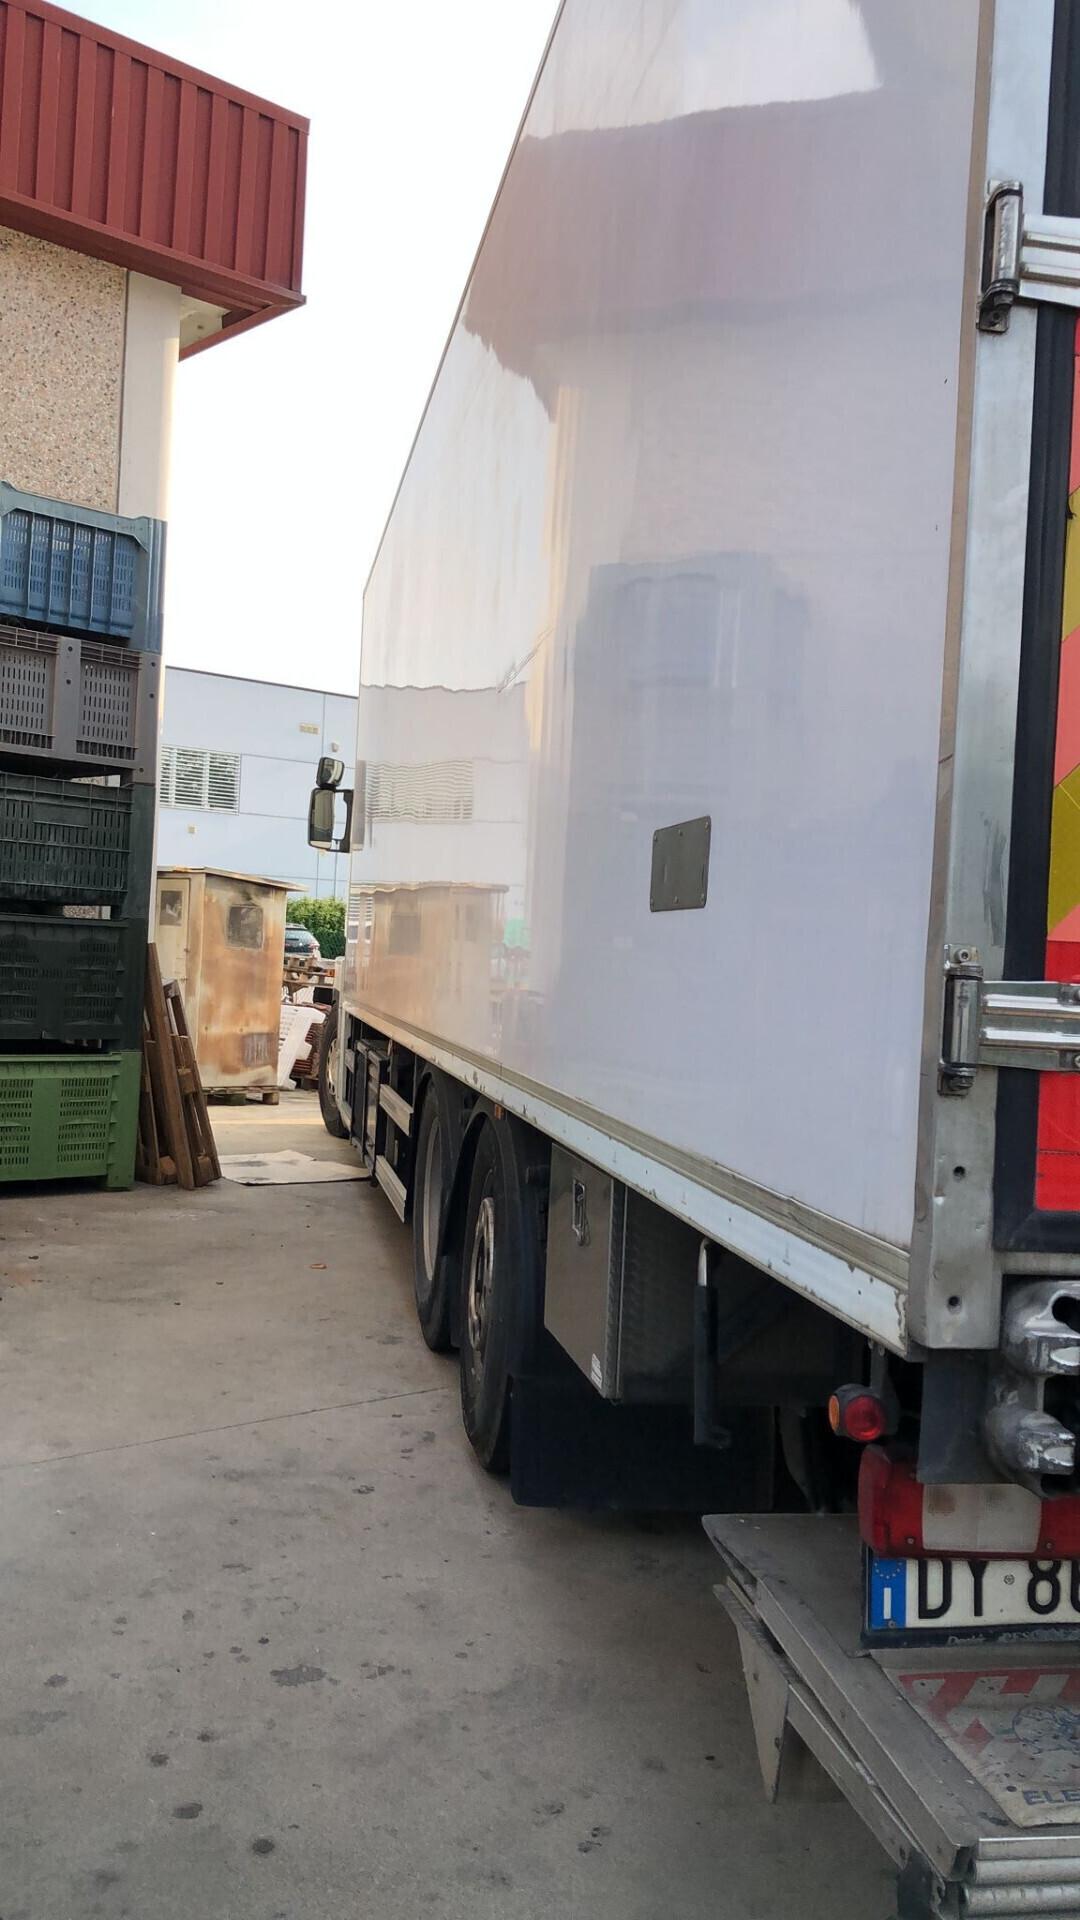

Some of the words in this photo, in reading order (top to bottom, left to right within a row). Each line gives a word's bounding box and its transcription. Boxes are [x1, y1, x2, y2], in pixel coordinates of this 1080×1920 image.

[883, 1587, 892, 1619] I
[918, 1560, 989, 1619] DY
[1027, 1560, 1080, 1614] 8
